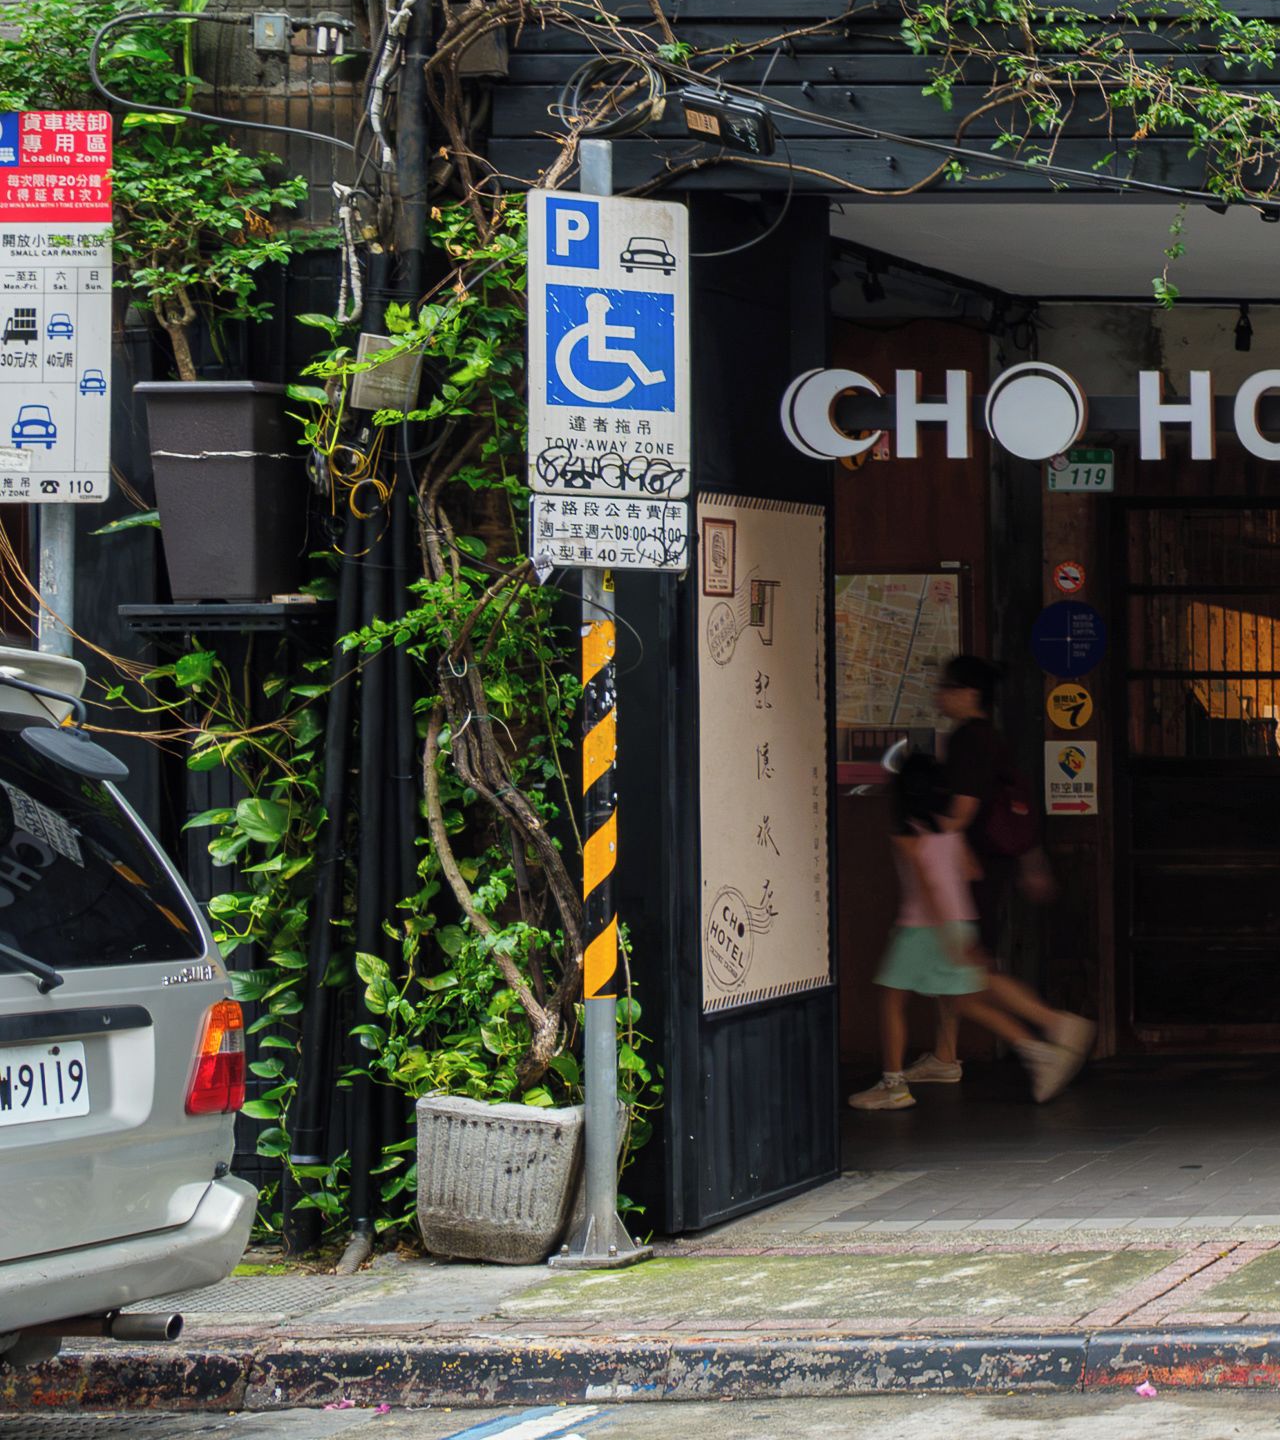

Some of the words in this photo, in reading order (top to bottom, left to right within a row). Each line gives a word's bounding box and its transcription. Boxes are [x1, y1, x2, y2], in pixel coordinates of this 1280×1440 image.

[22, 113, 107, 132] 貨車裝卸
[22, 133, 107, 152] 專用區
[23, 154, 70, 165] Loading
[76, 153, 106, 163] Zone
[7, 174, 101, 188] 每次限停20分鐘
[556, 208, 590, 257] P
[5, 270, 37, 281] 一至五
[56, 271, 66, 281] 六
[90, 270, 99, 281] 日
[569, 415, 652, 435] 違者拖吊
[545, 436, 628, 453] TOW-AWAY
[635, 441, 674, 455] ZONE
[1071, 468, 1106, 486] 119
[70, 480, 94, 494] 110
[541, 499, 682, 520] 本路段公告費率
[710, 921, 744, 969] HOTEL
